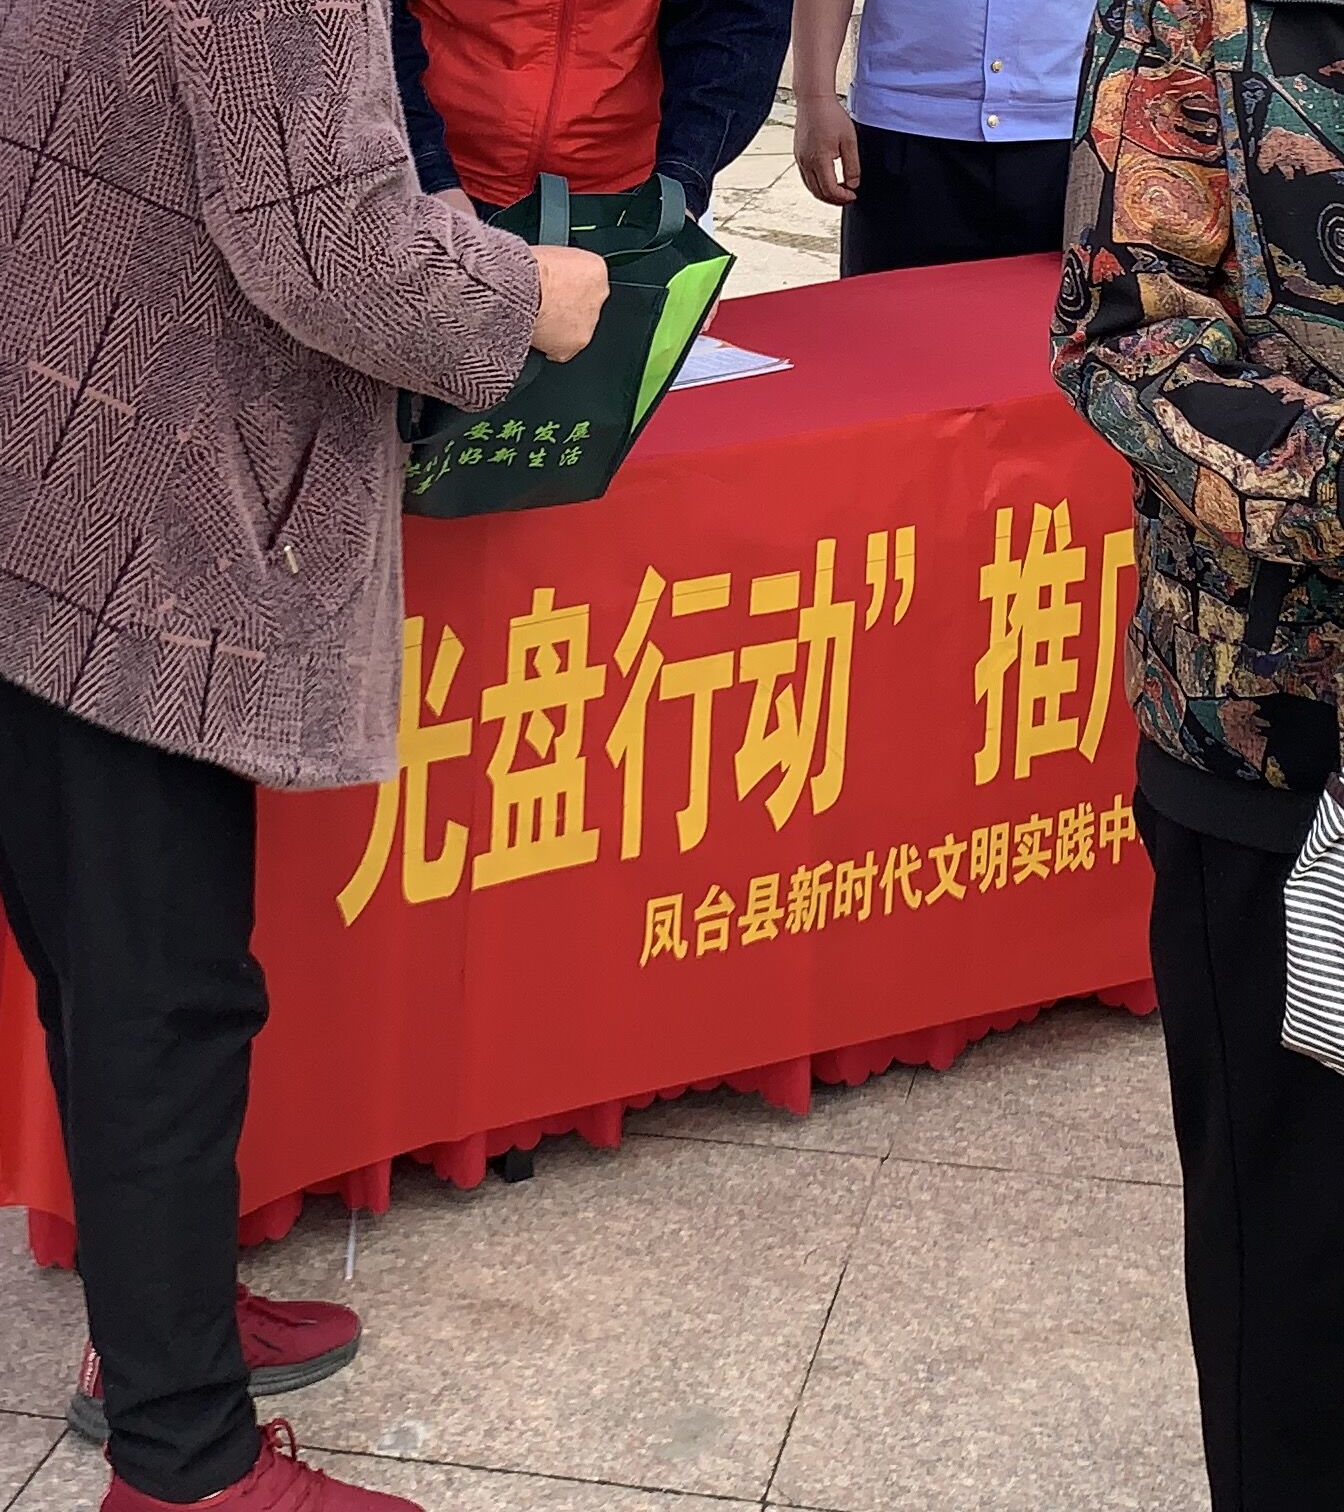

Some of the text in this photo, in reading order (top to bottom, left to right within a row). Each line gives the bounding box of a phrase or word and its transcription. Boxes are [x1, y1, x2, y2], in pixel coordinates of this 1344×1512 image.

[639, 791, 1145, 968] 凤台县新时代文明实践中
